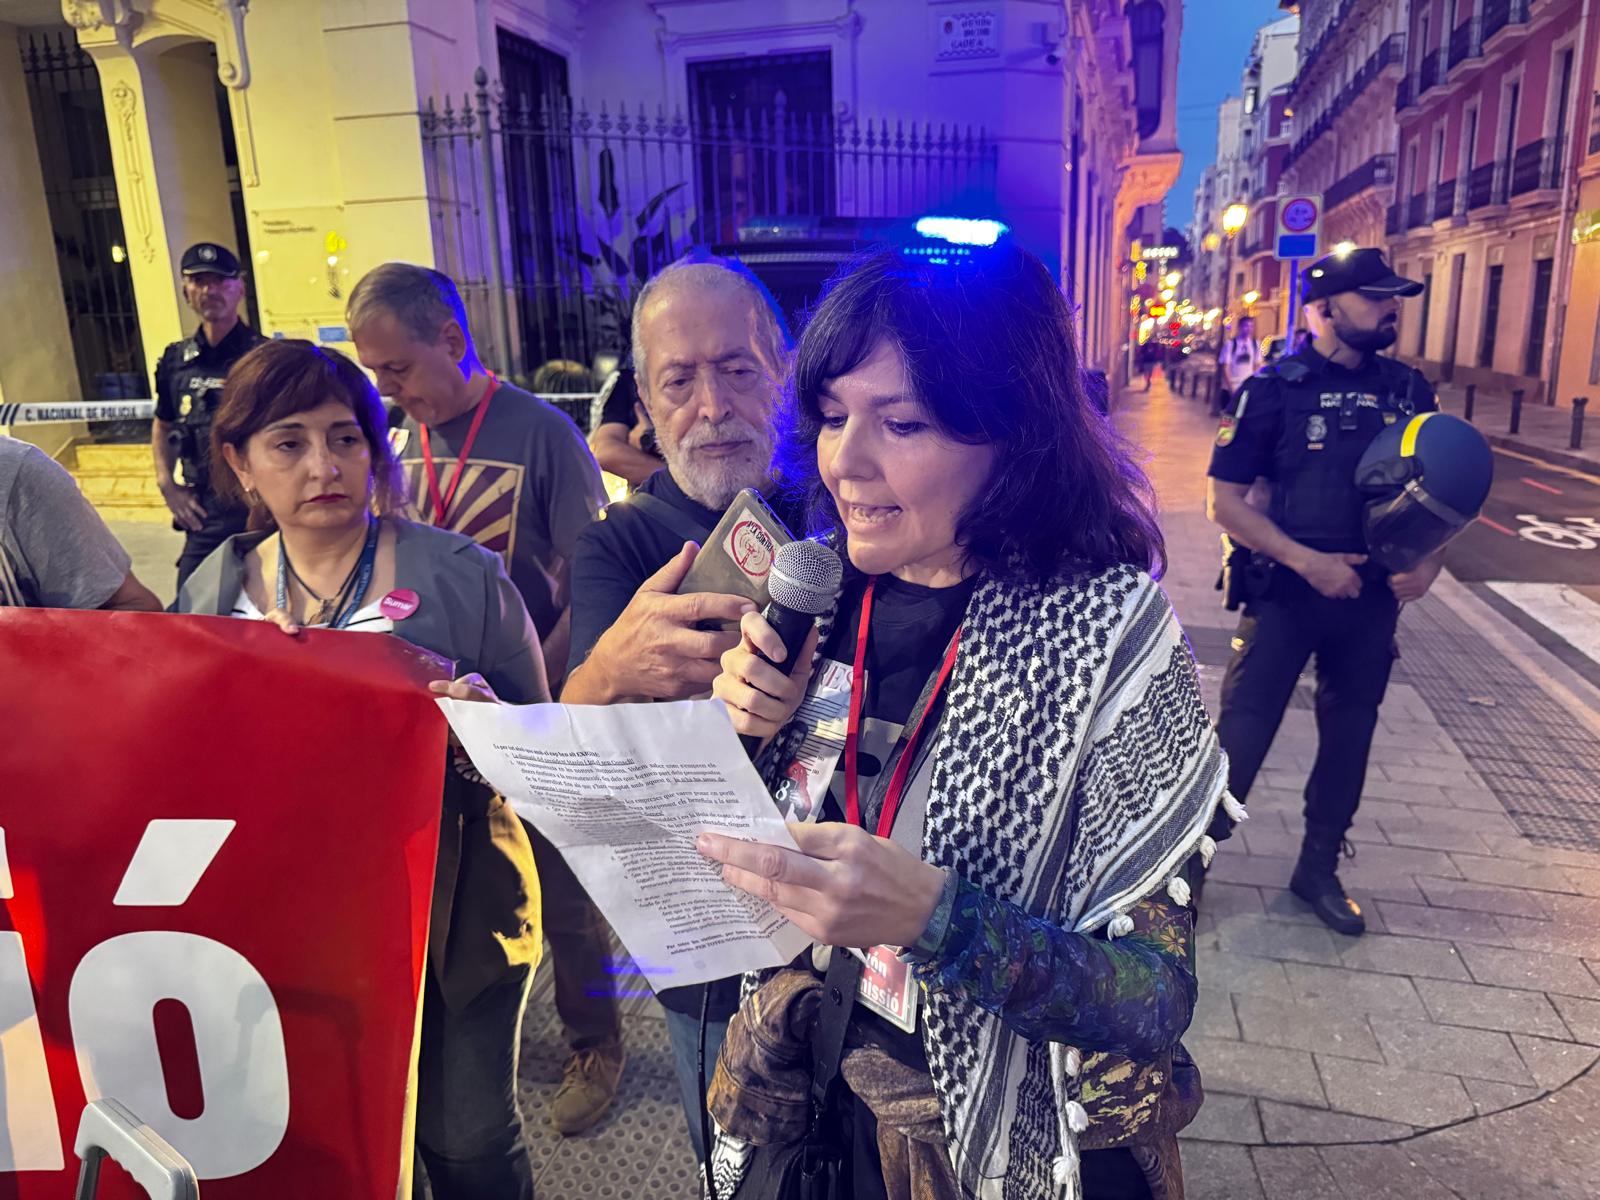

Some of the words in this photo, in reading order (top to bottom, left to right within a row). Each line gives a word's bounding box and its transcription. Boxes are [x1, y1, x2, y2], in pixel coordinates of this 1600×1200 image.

[37, 407, 84, 421] NACIONAL
[86, 406, 97, 420] DE
[383, 597, 414, 611] Sumar
